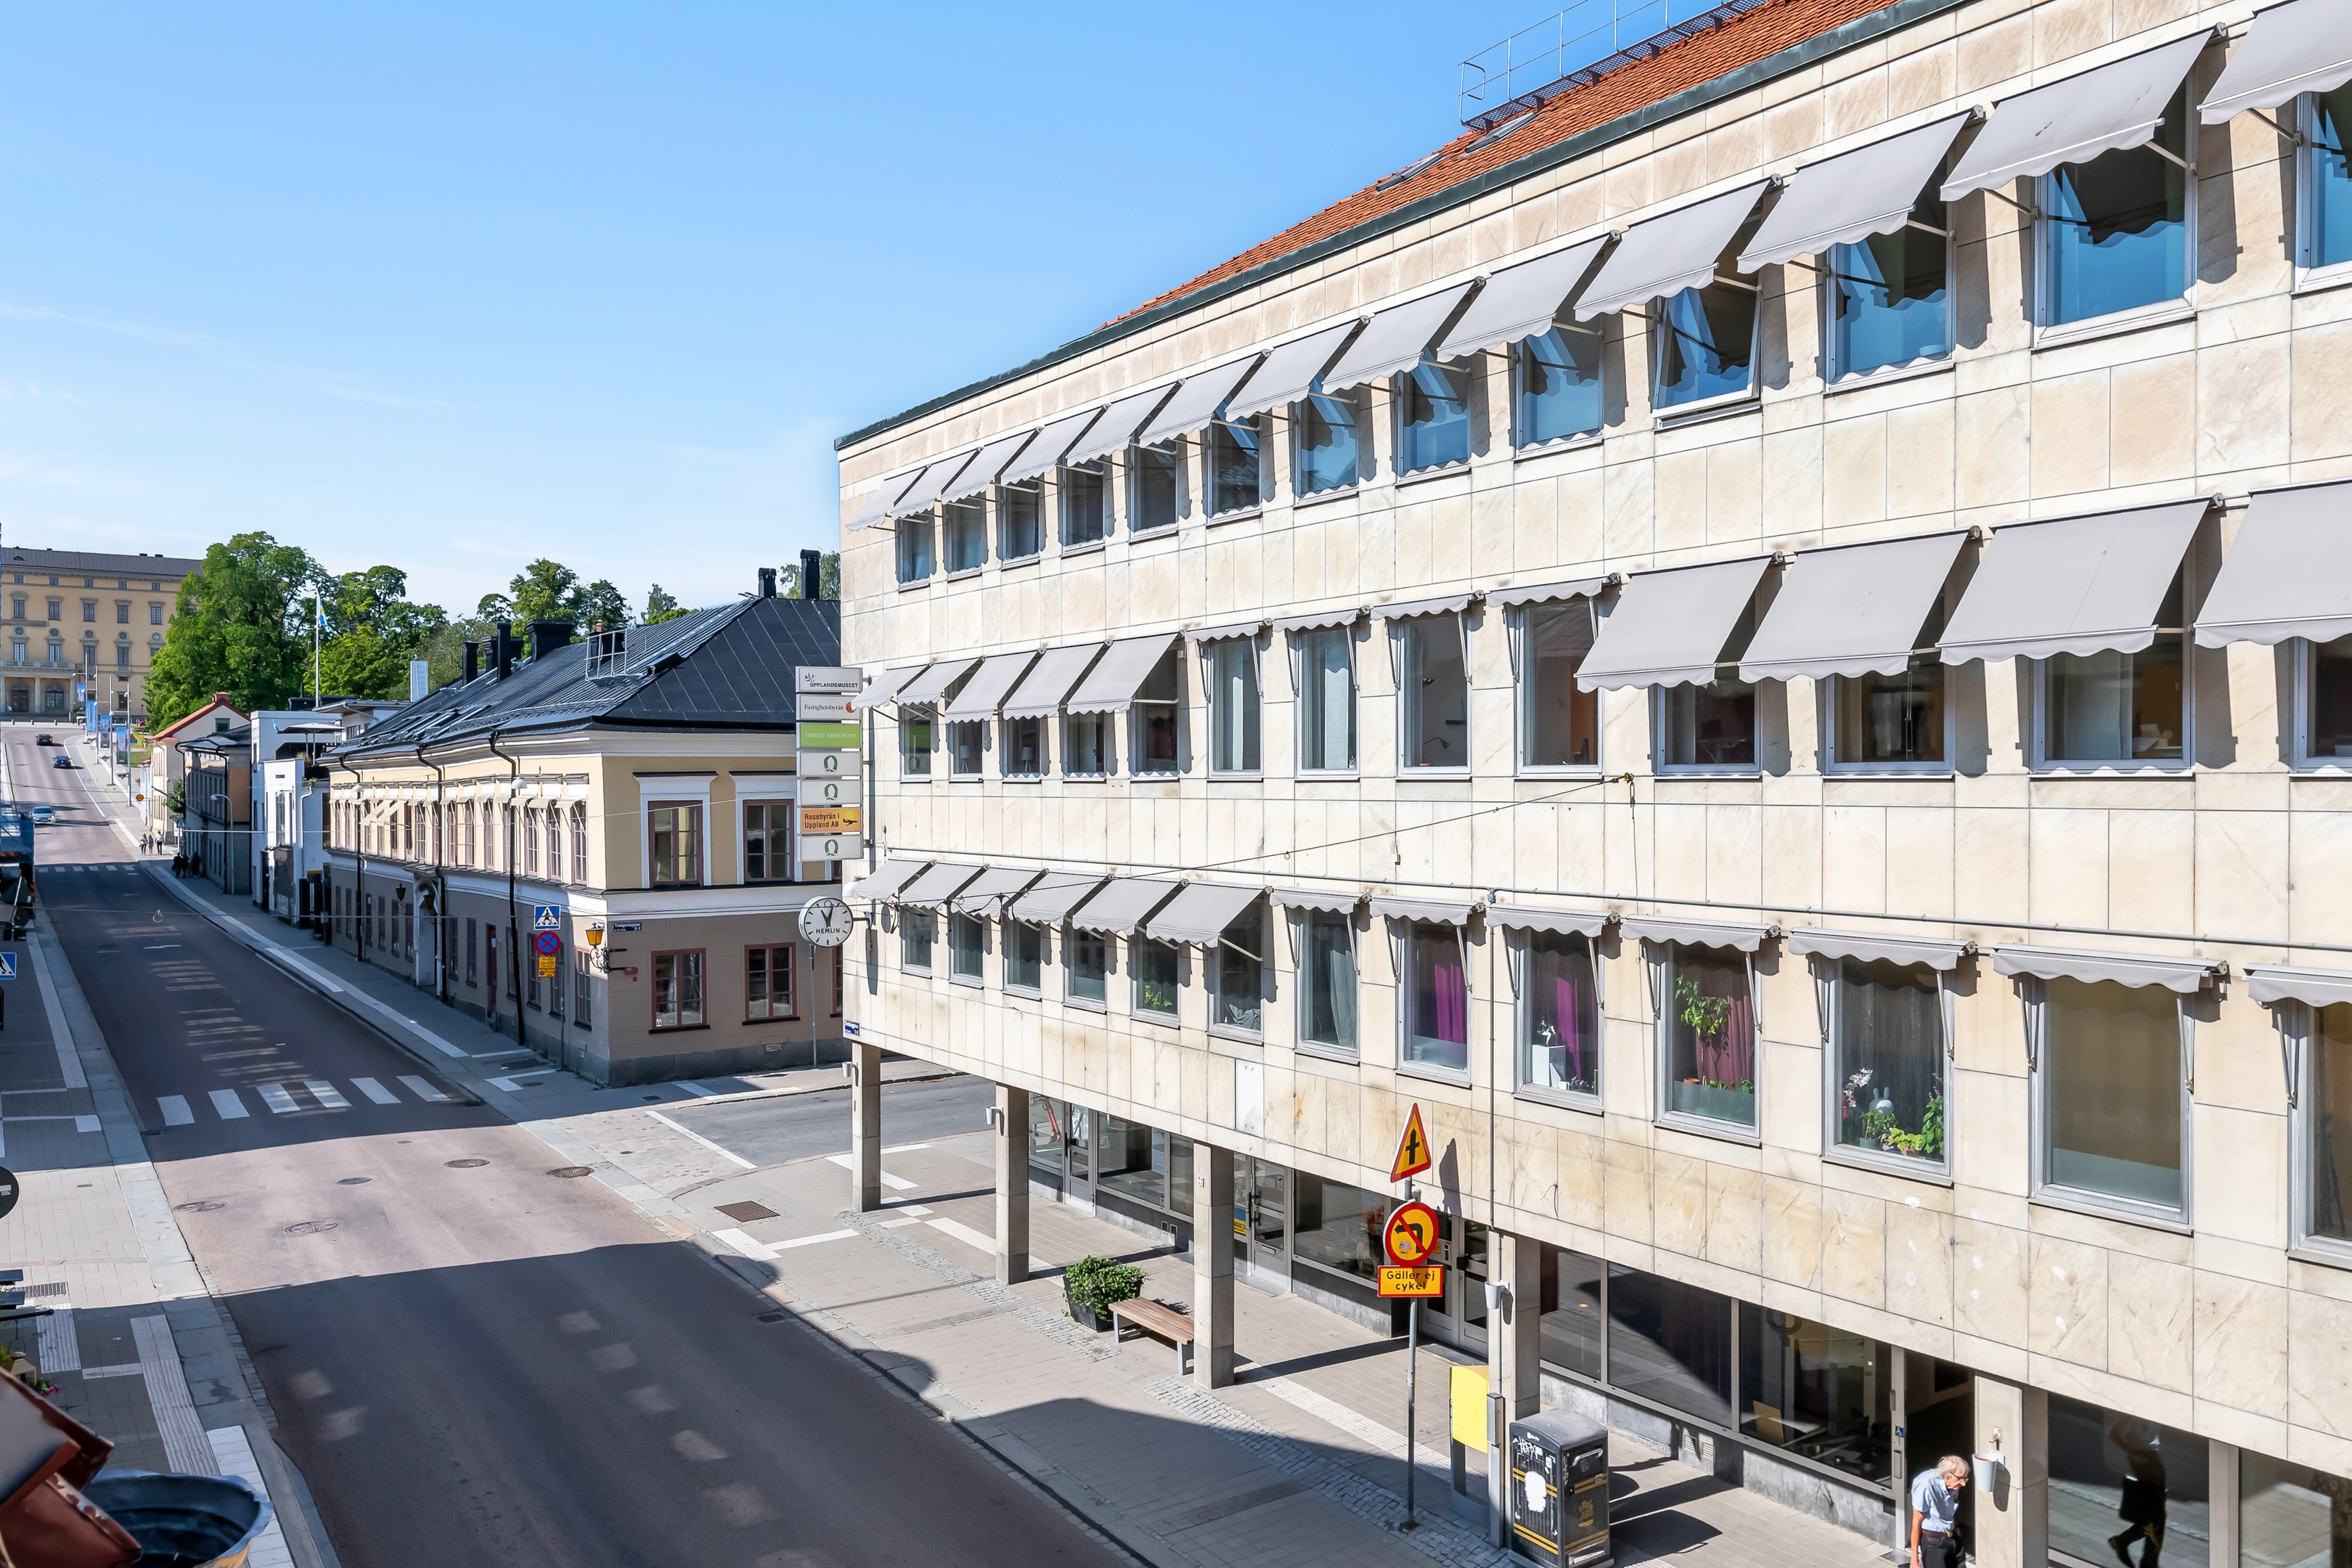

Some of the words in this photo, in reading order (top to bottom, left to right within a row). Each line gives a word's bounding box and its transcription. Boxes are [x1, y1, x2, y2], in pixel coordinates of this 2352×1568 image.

[804, 812, 836, 821] Resebyrån
[1387, 1270, 1421, 1280] Gäller
[1424, 1270, 1435, 1282] ej
[1395, 1281, 1426, 1292] cykel
